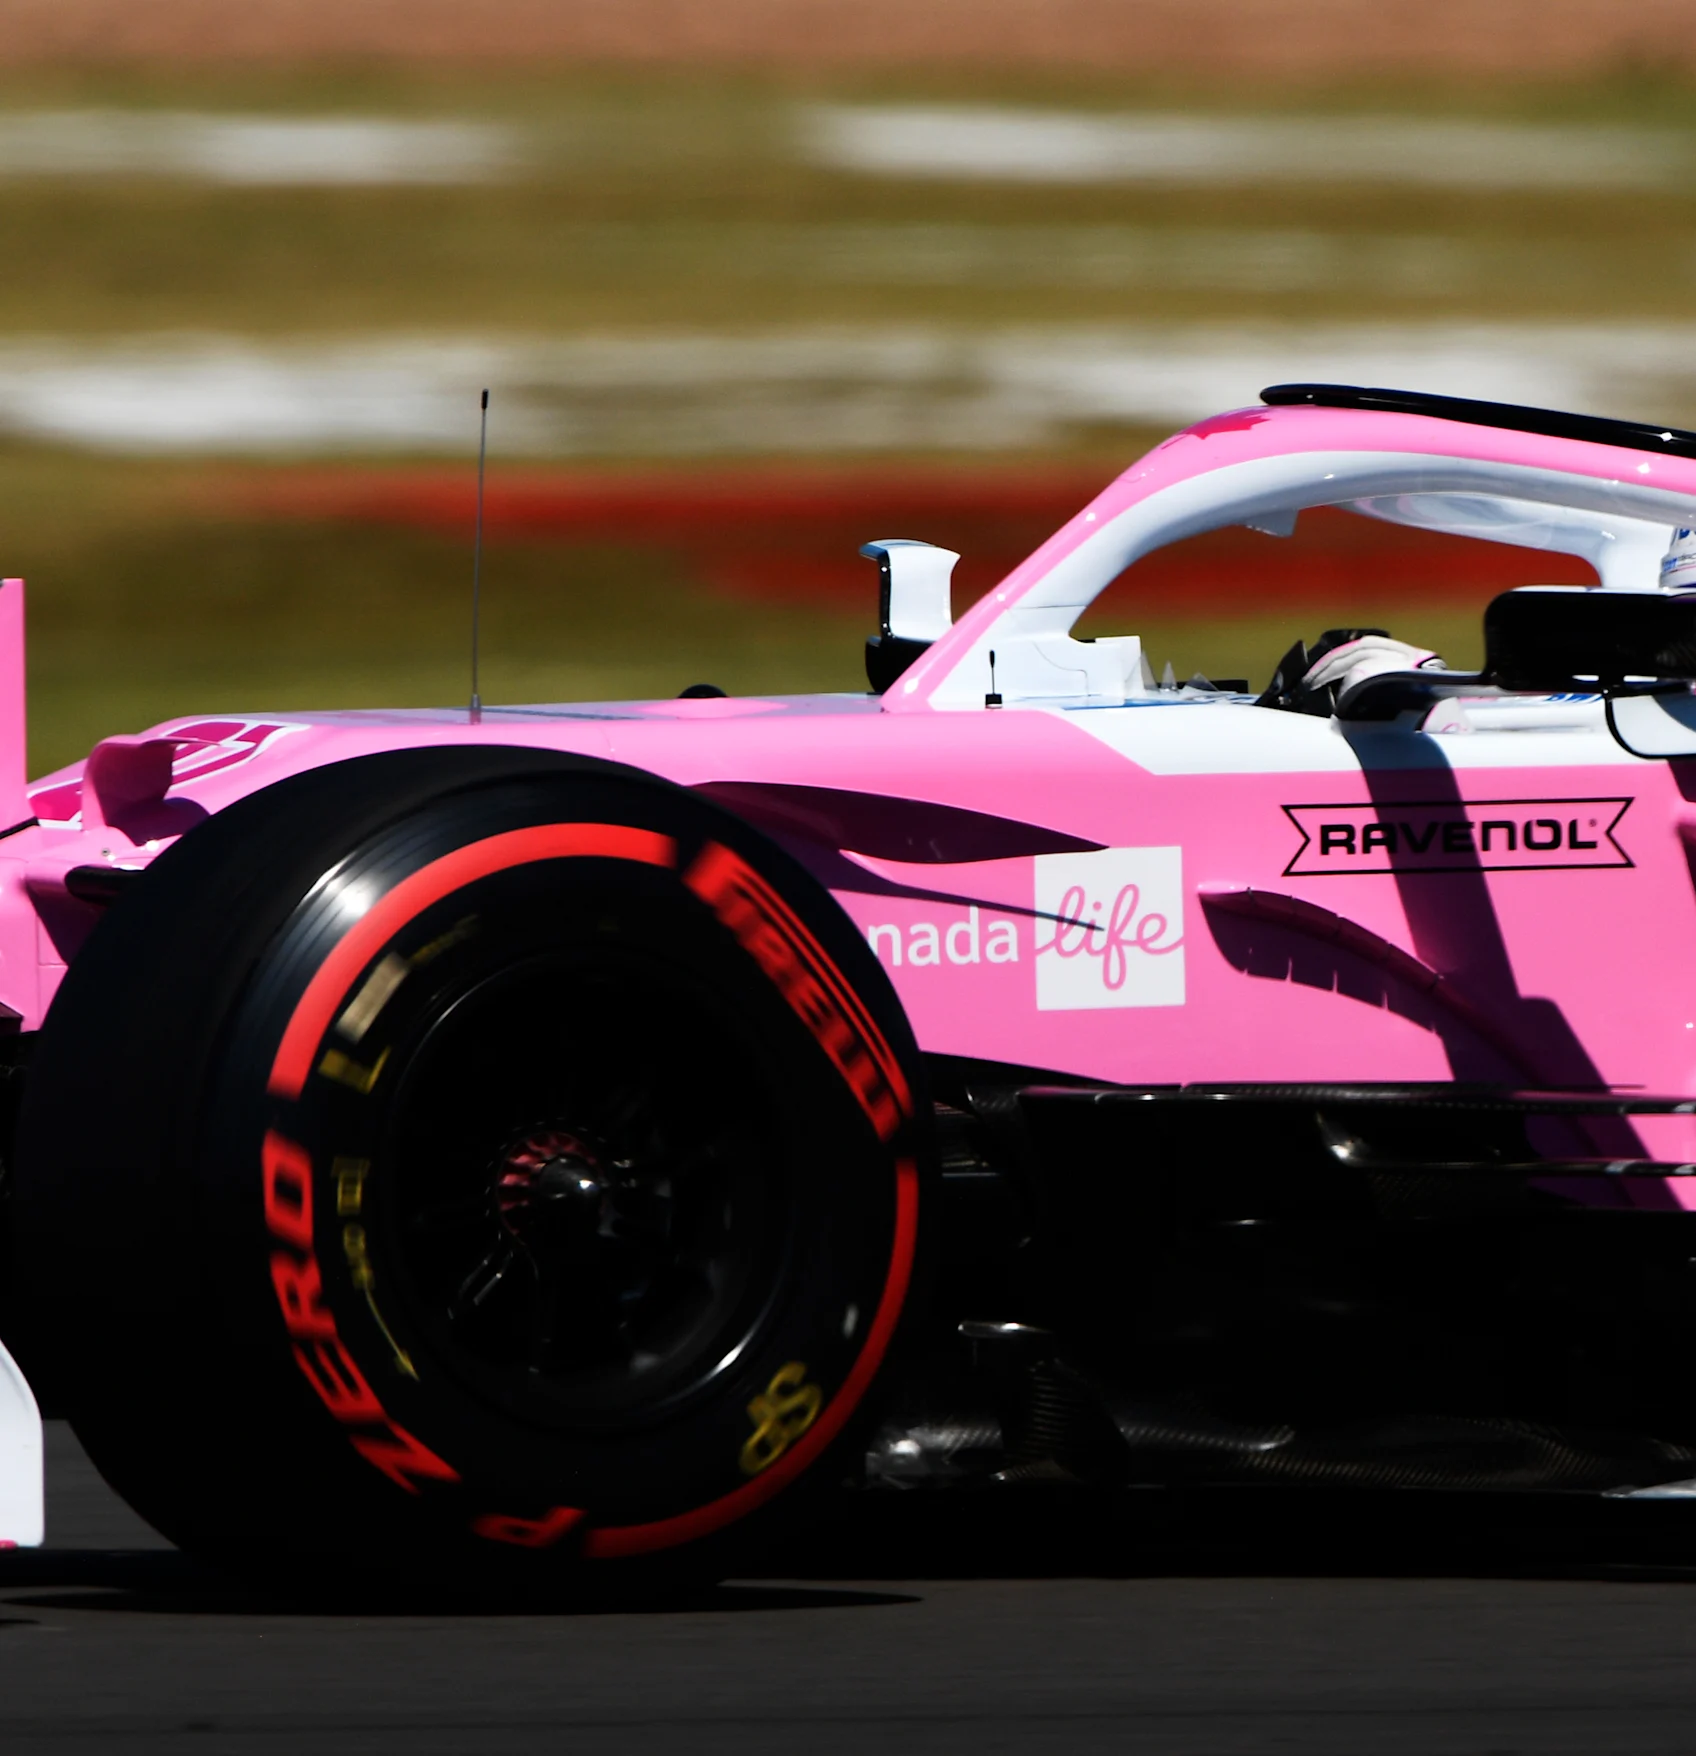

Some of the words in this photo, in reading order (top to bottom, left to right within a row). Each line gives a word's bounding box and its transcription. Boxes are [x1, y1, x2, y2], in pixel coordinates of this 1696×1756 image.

[868, 905, 1019, 966] nada
[1034, 884, 1185, 990] life
[262, 1127, 463, 1497] ZERO
